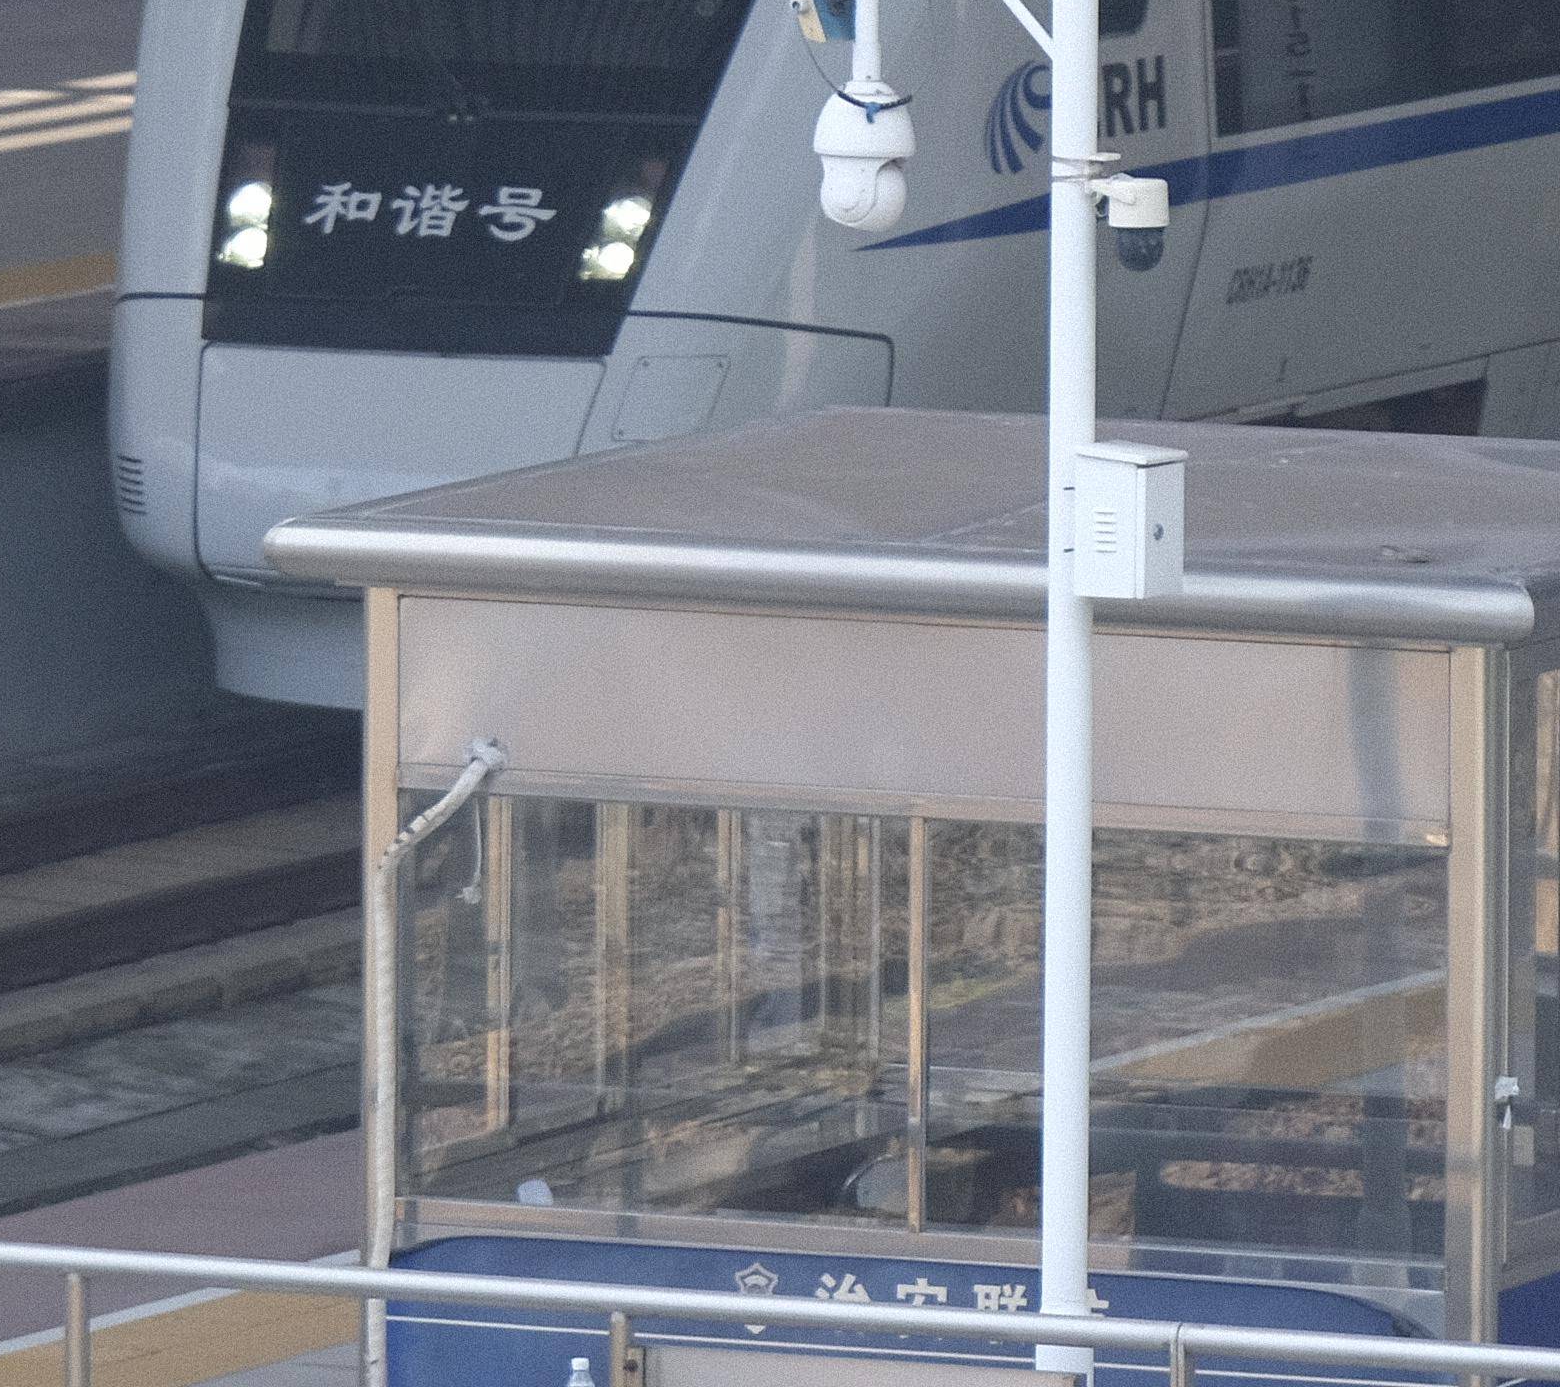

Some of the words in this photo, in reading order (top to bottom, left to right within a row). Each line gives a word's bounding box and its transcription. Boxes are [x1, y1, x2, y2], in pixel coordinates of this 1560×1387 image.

[1099, 55, 1167, 138] RH
[305, 180, 557, 244] 和谐号
[814, 1272, 1110, 1344] 治安联
